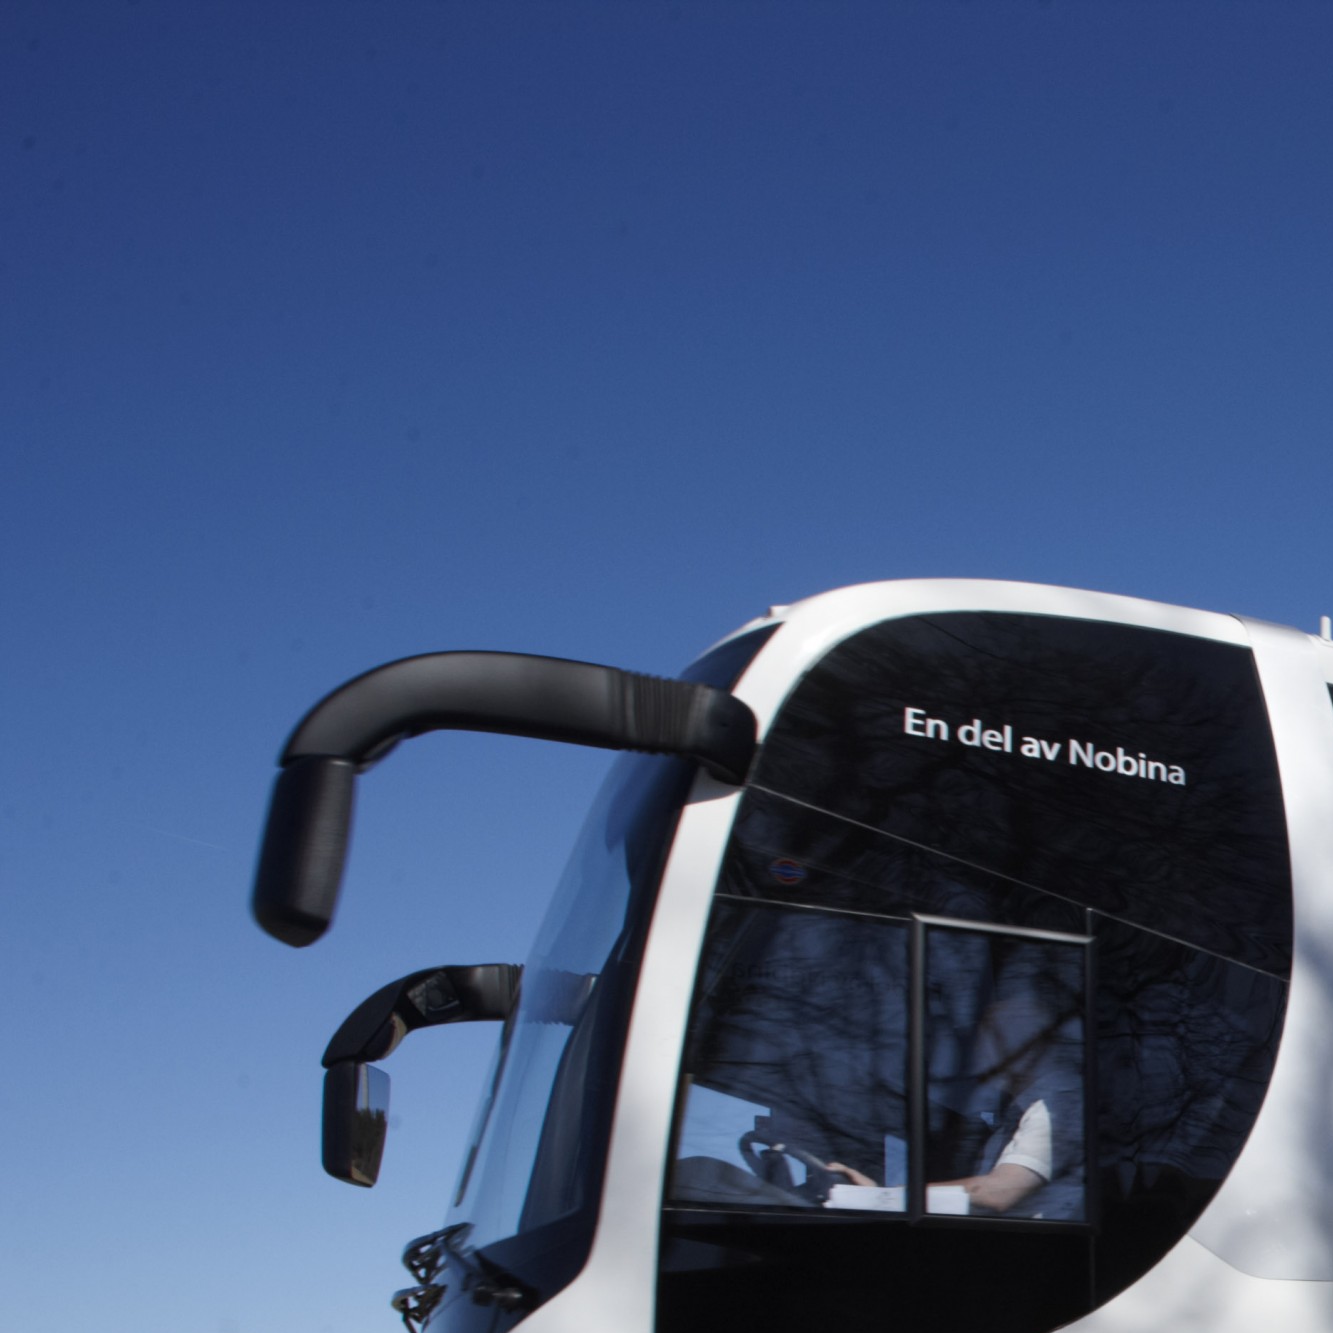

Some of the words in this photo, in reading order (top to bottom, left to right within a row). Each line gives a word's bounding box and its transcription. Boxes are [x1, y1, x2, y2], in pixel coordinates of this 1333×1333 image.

[904, 706, 948, 741] En
[957, 719, 1013, 753] del
[1020, 736, 1061, 761] av
[1068, 738, 1187, 787] Nobina
